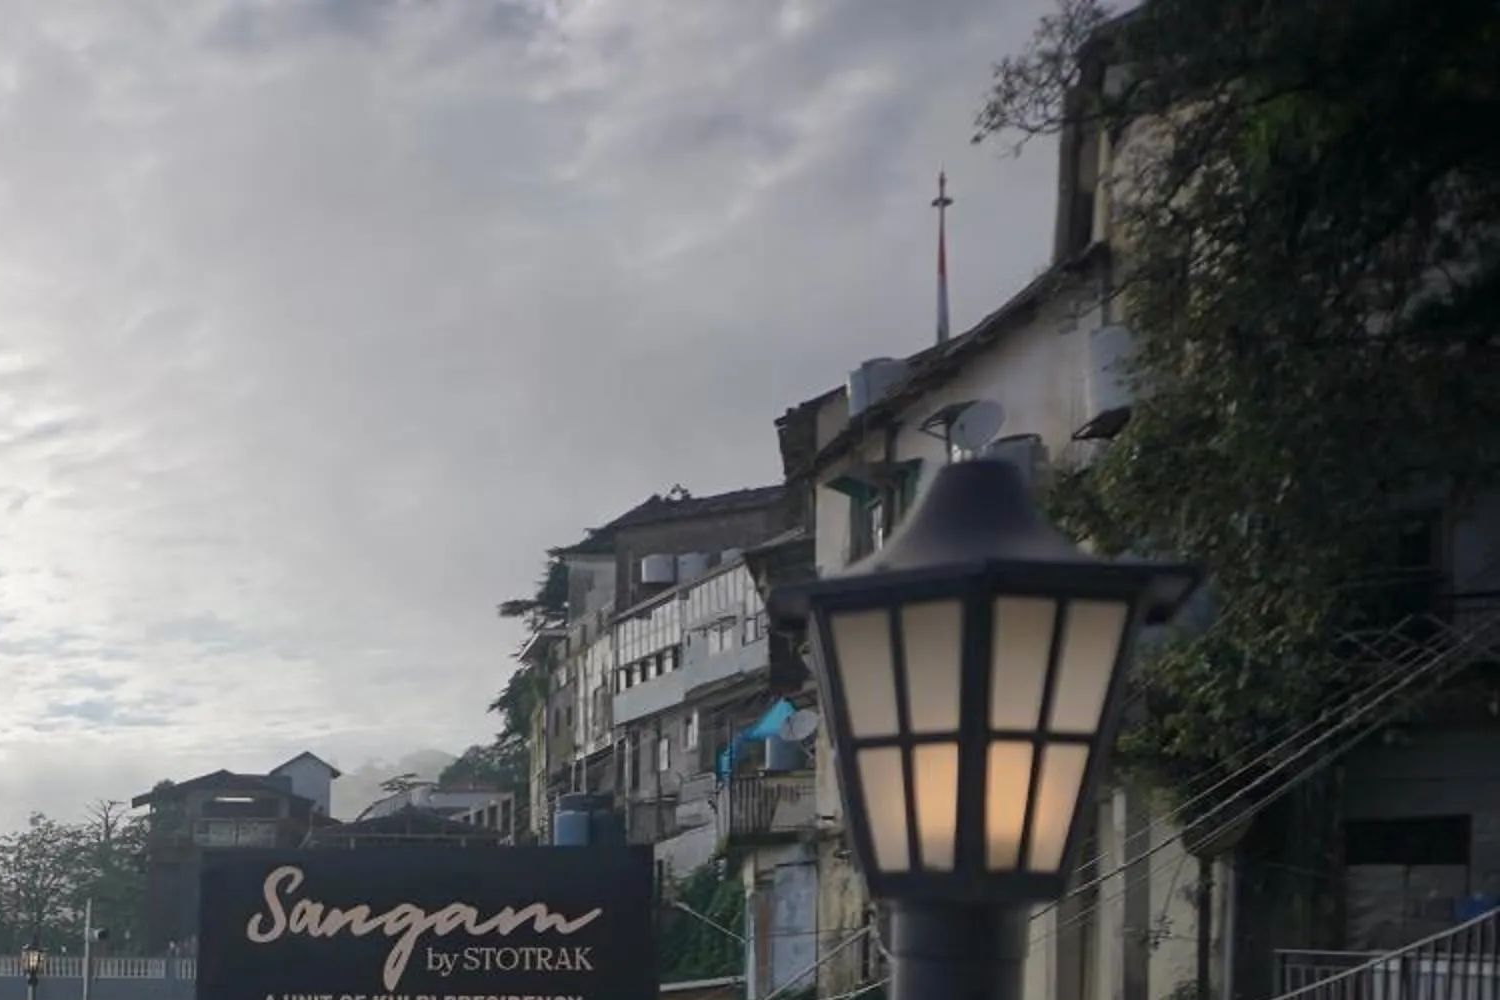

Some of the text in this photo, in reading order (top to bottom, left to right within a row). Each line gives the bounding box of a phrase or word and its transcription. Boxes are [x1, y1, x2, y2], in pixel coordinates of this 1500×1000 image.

[246, 865, 603, 992] Sangam
[426, 947, 593, 977] by STOTRAK
